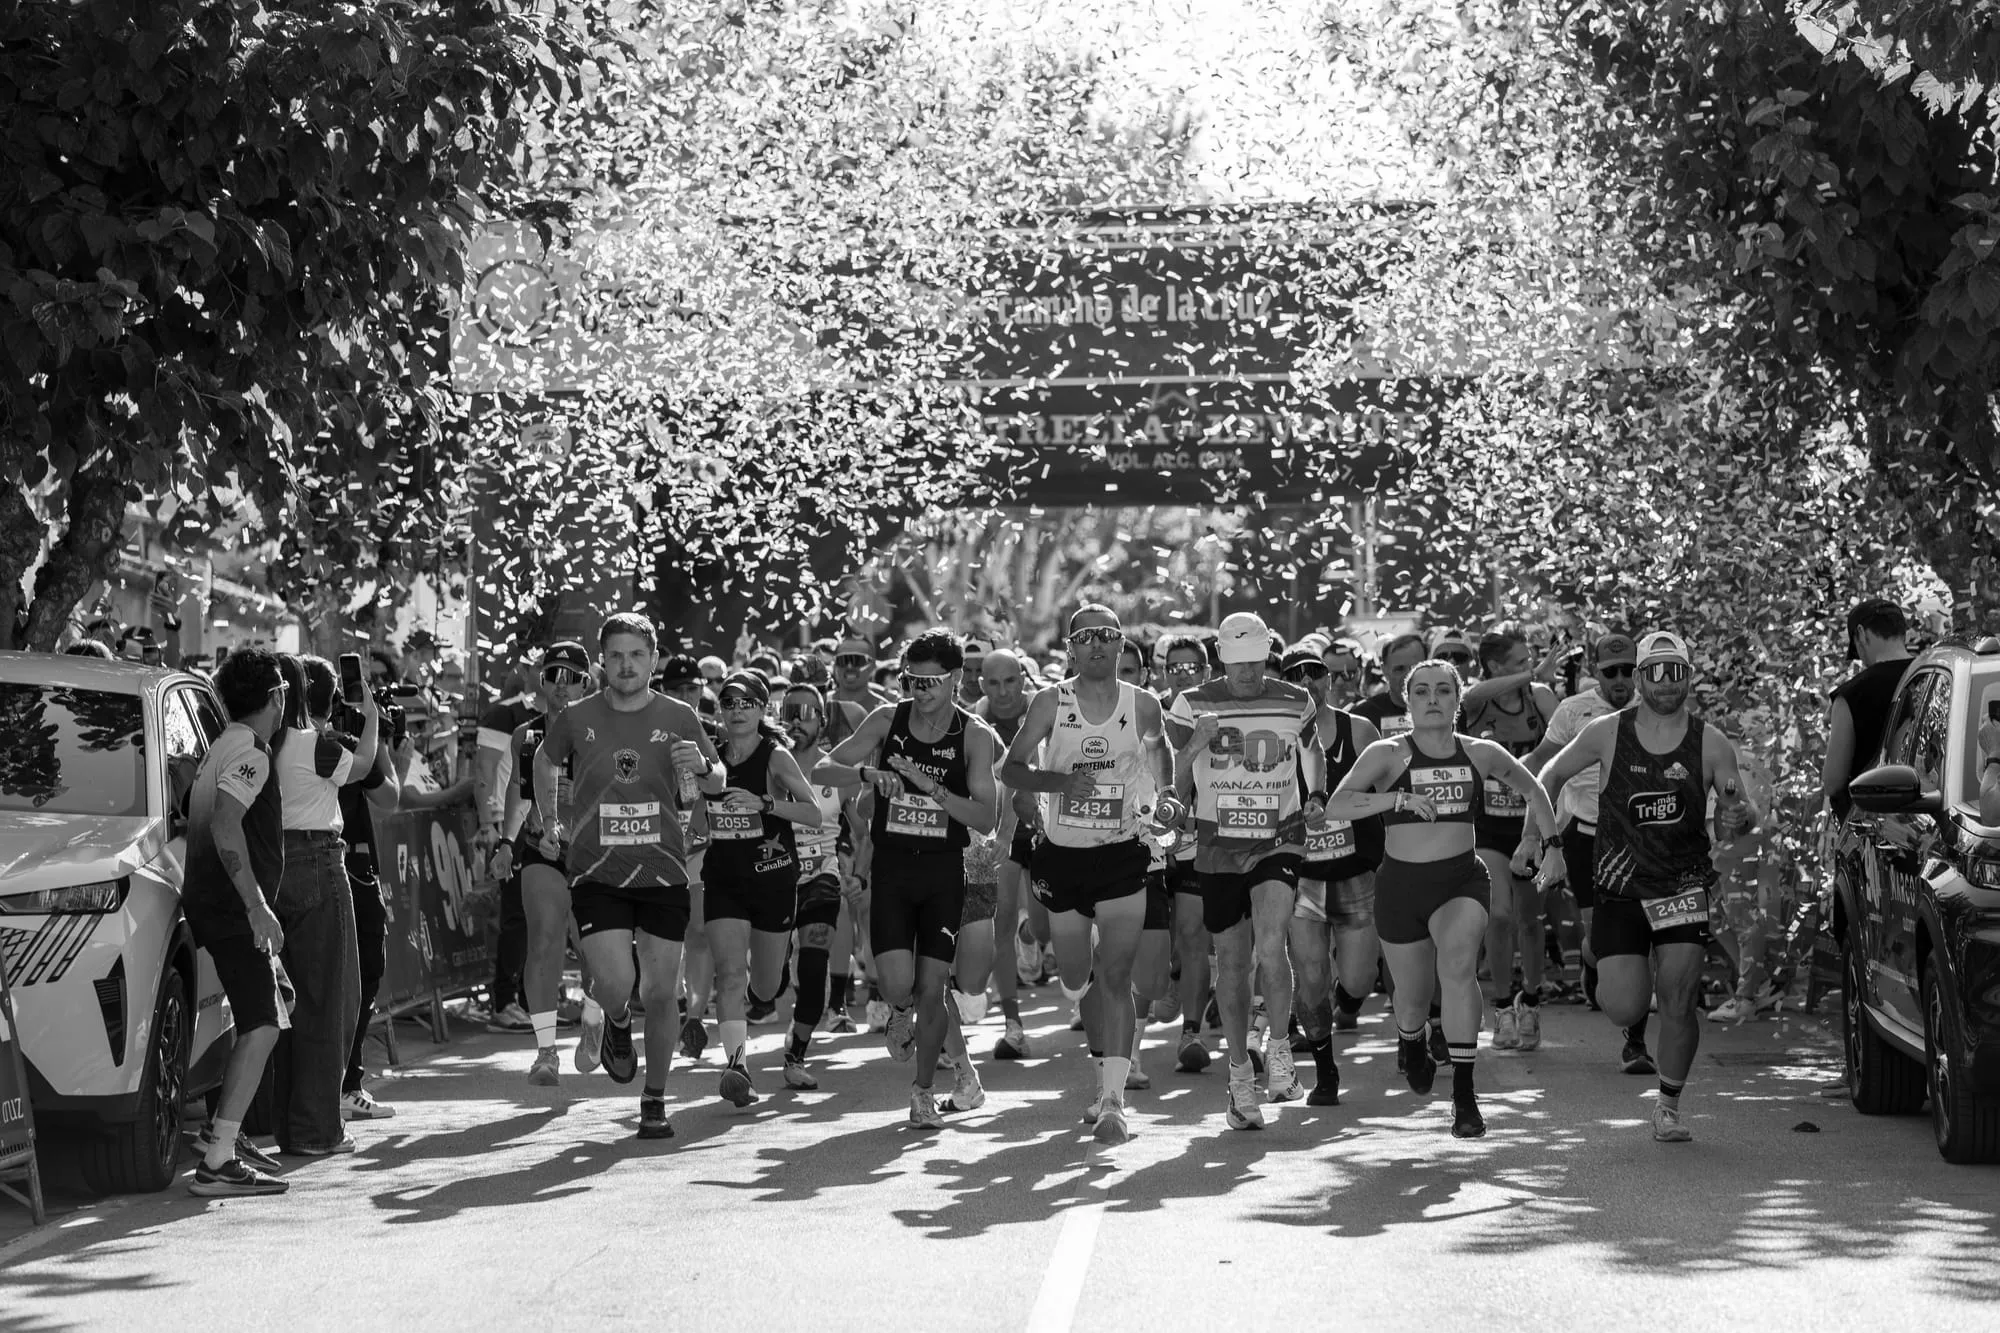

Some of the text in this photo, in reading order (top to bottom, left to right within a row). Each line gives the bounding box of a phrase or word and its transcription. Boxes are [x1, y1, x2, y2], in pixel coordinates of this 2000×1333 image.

[1121, 285, 1159, 322] de
[1166, 285, 1197, 321] la
[914, 761, 948, 777] VICKY
[1209, 780, 1263, 790] AVANZA
[1424, 785, 1464, 801] 2210
[1657, 794, 1677, 805] más
[1069, 800, 1112, 816] 2434
[1635, 802, 1677, 820] Trigo
[715, 816, 751, 829] 2055
[897, 808, 939, 825] 2494
[1227, 811, 1268, 826] 2550
[609, 818, 651, 833] 2404
[1308, 832, 1346, 850] 2428
[754, 855, 793, 873] CaixaBank
[1655, 896, 1698, 917] 2445
